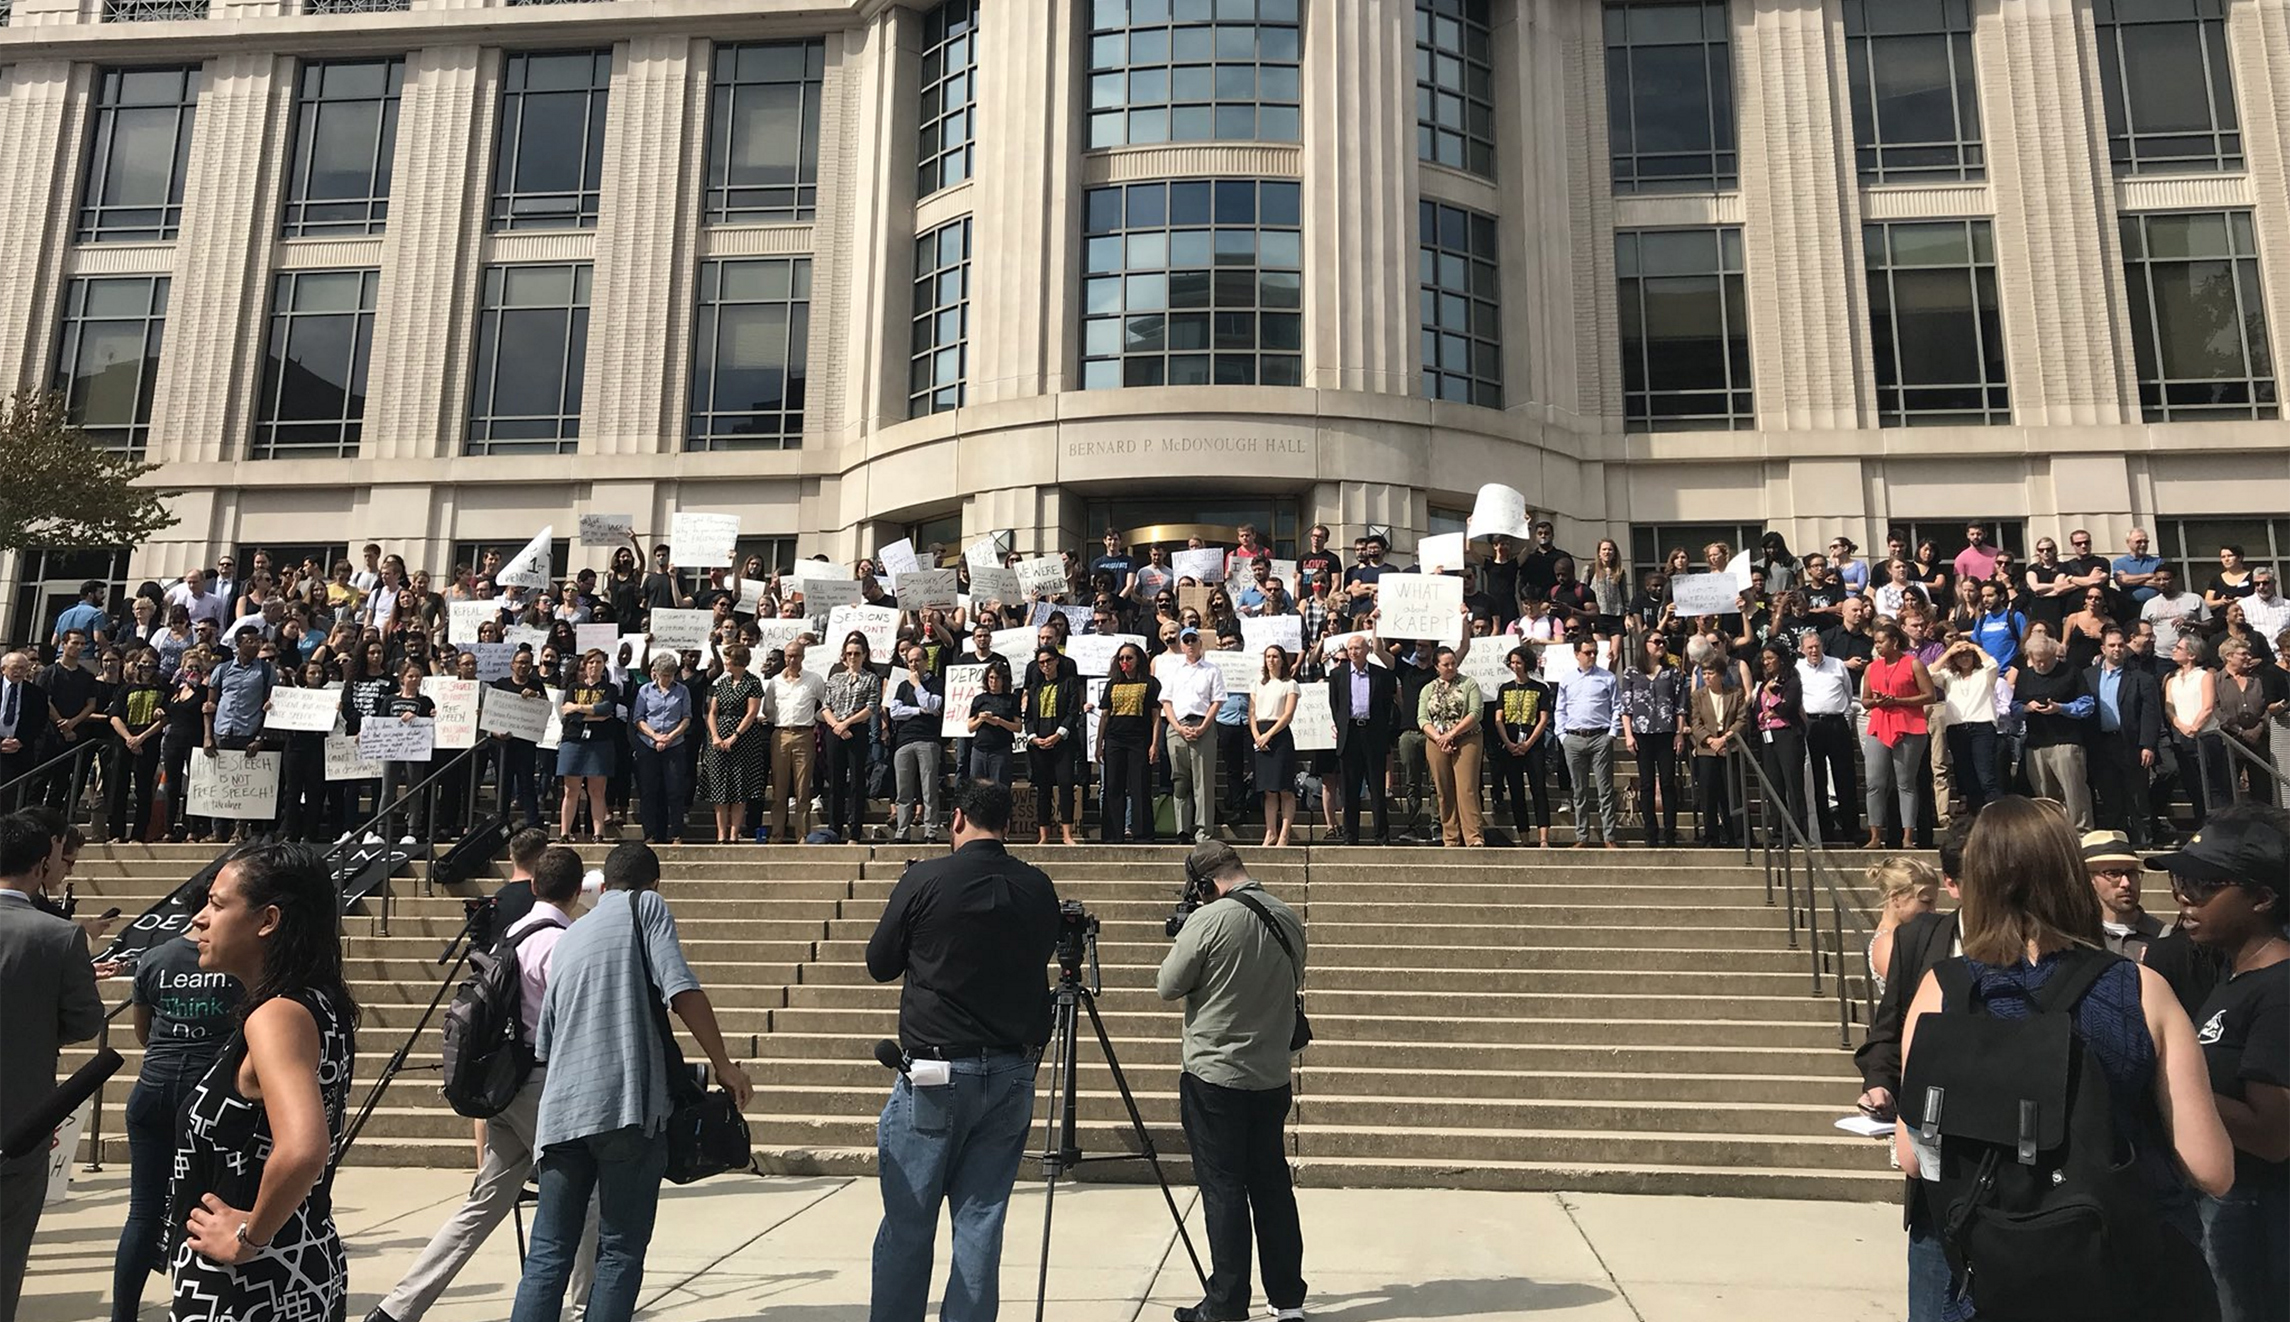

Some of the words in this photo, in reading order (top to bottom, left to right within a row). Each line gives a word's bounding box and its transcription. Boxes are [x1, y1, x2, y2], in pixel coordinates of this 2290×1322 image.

[1069, 439, 1137, 456] BERNARD
[1143, 440, 1153, 453] P.
[1161, 437, 1257, 452] McDONOUGH
[1265, 438, 1306, 453] HALL
[1017, 564, 1030, 579] WE
[1033, 562, 1060, 577] WERE
[1303, 559, 1329, 569] LOVE
[1394, 582, 1443, 600] WHAT
[453, 606, 482, 616] REPEAL
[1403, 604, 1429, 614] about
[833, 610, 890, 624] SESSIONS
[442, 702, 461, 714] FREE
[437, 711, 466, 723] SPEECH
[197, 753, 228, 776] HATE
[230, 752, 272, 772] SPEECH
[231, 773, 252, 786] NOT
[193, 784, 217, 800] FREE
[221, 785, 274, 799] SPEECH!
[159, 969, 233, 989] Learn.
[160, 997, 230, 1018] Think.
